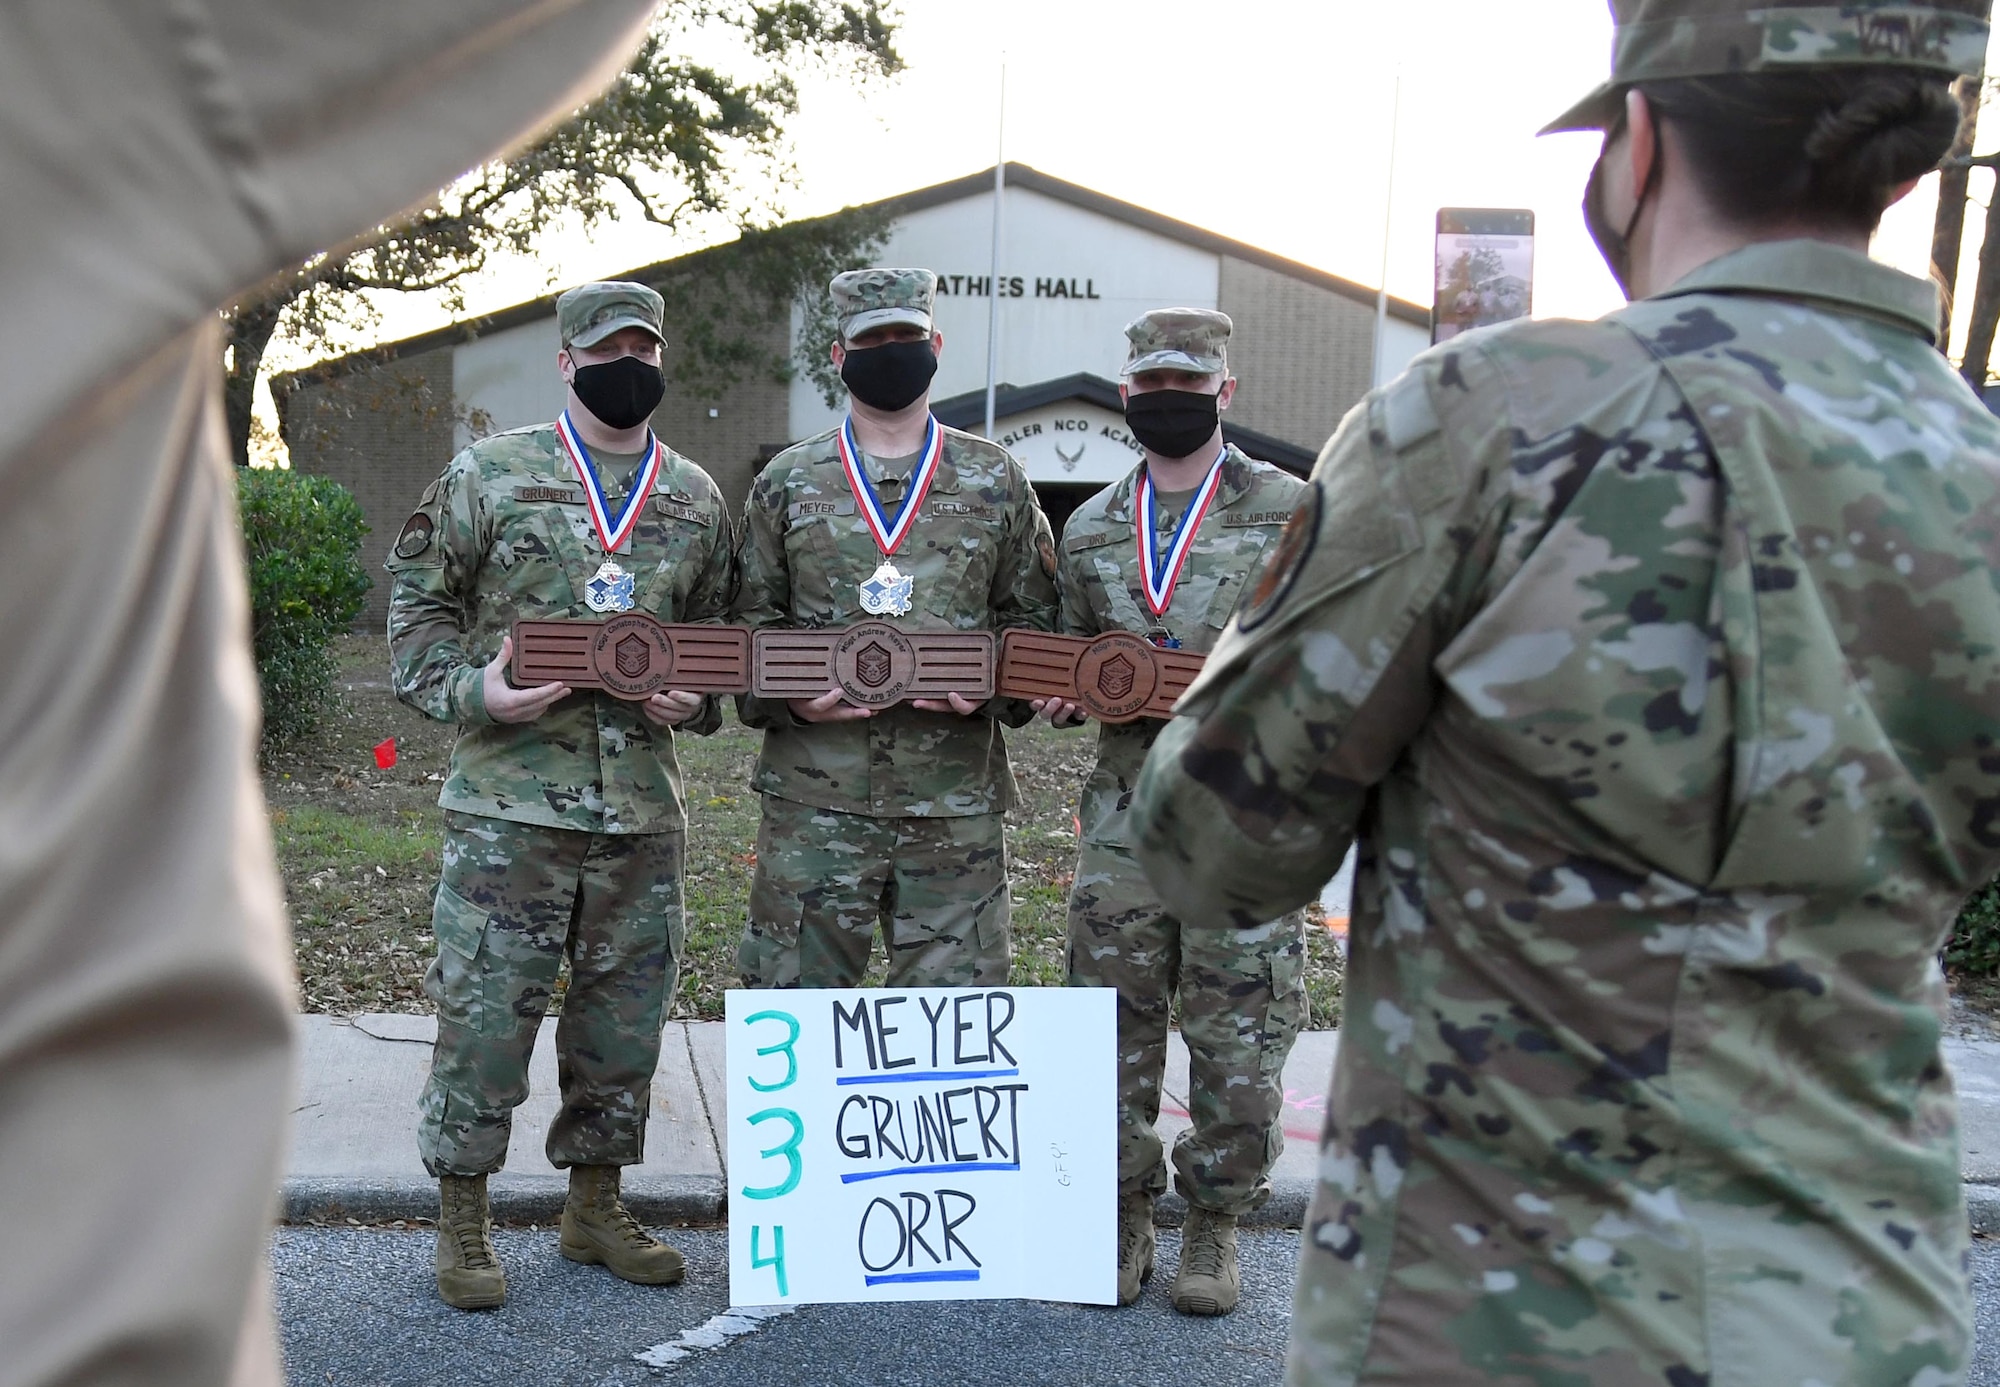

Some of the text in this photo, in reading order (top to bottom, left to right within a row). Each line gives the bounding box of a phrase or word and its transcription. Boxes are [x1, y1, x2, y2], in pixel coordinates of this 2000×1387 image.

[936, 275, 1100, 299] ATHIES HALL
[1054, 419, 1089, 431] NCO
[1099, 425, 1144, 456] ACADE
[522, 486, 576, 502] GRUNERT
[673, 506, 687, 519] AIR
[687, 509, 711, 525] FORCE
[799, 502, 836, 514] MEYER
[1226, 511, 1292, 524] U.S. AIR FORC
[1089, 532, 1107, 546] ORR
[607, 619, 649, 634] Christopher
[840, 628, 906, 653] MSgt Andrew Meyer
[1092, 641, 1111, 655] MSgt
[1137, 648, 1148, 660] Orr
[603, 671, 627, 690] Keesler
[646, 673, 662, 688] 2020
[843, 681, 903, 701] Keesler AFB 2020
[1107, 706, 1122, 714] AFB
[1124, 697, 1143, 712] 2020
[744, 991, 1018, 1092] 3 MEYER
[741, 1083, 1029, 1200] 3 GRUNERT
[751, 1189, 982, 1297] 4 ORR
